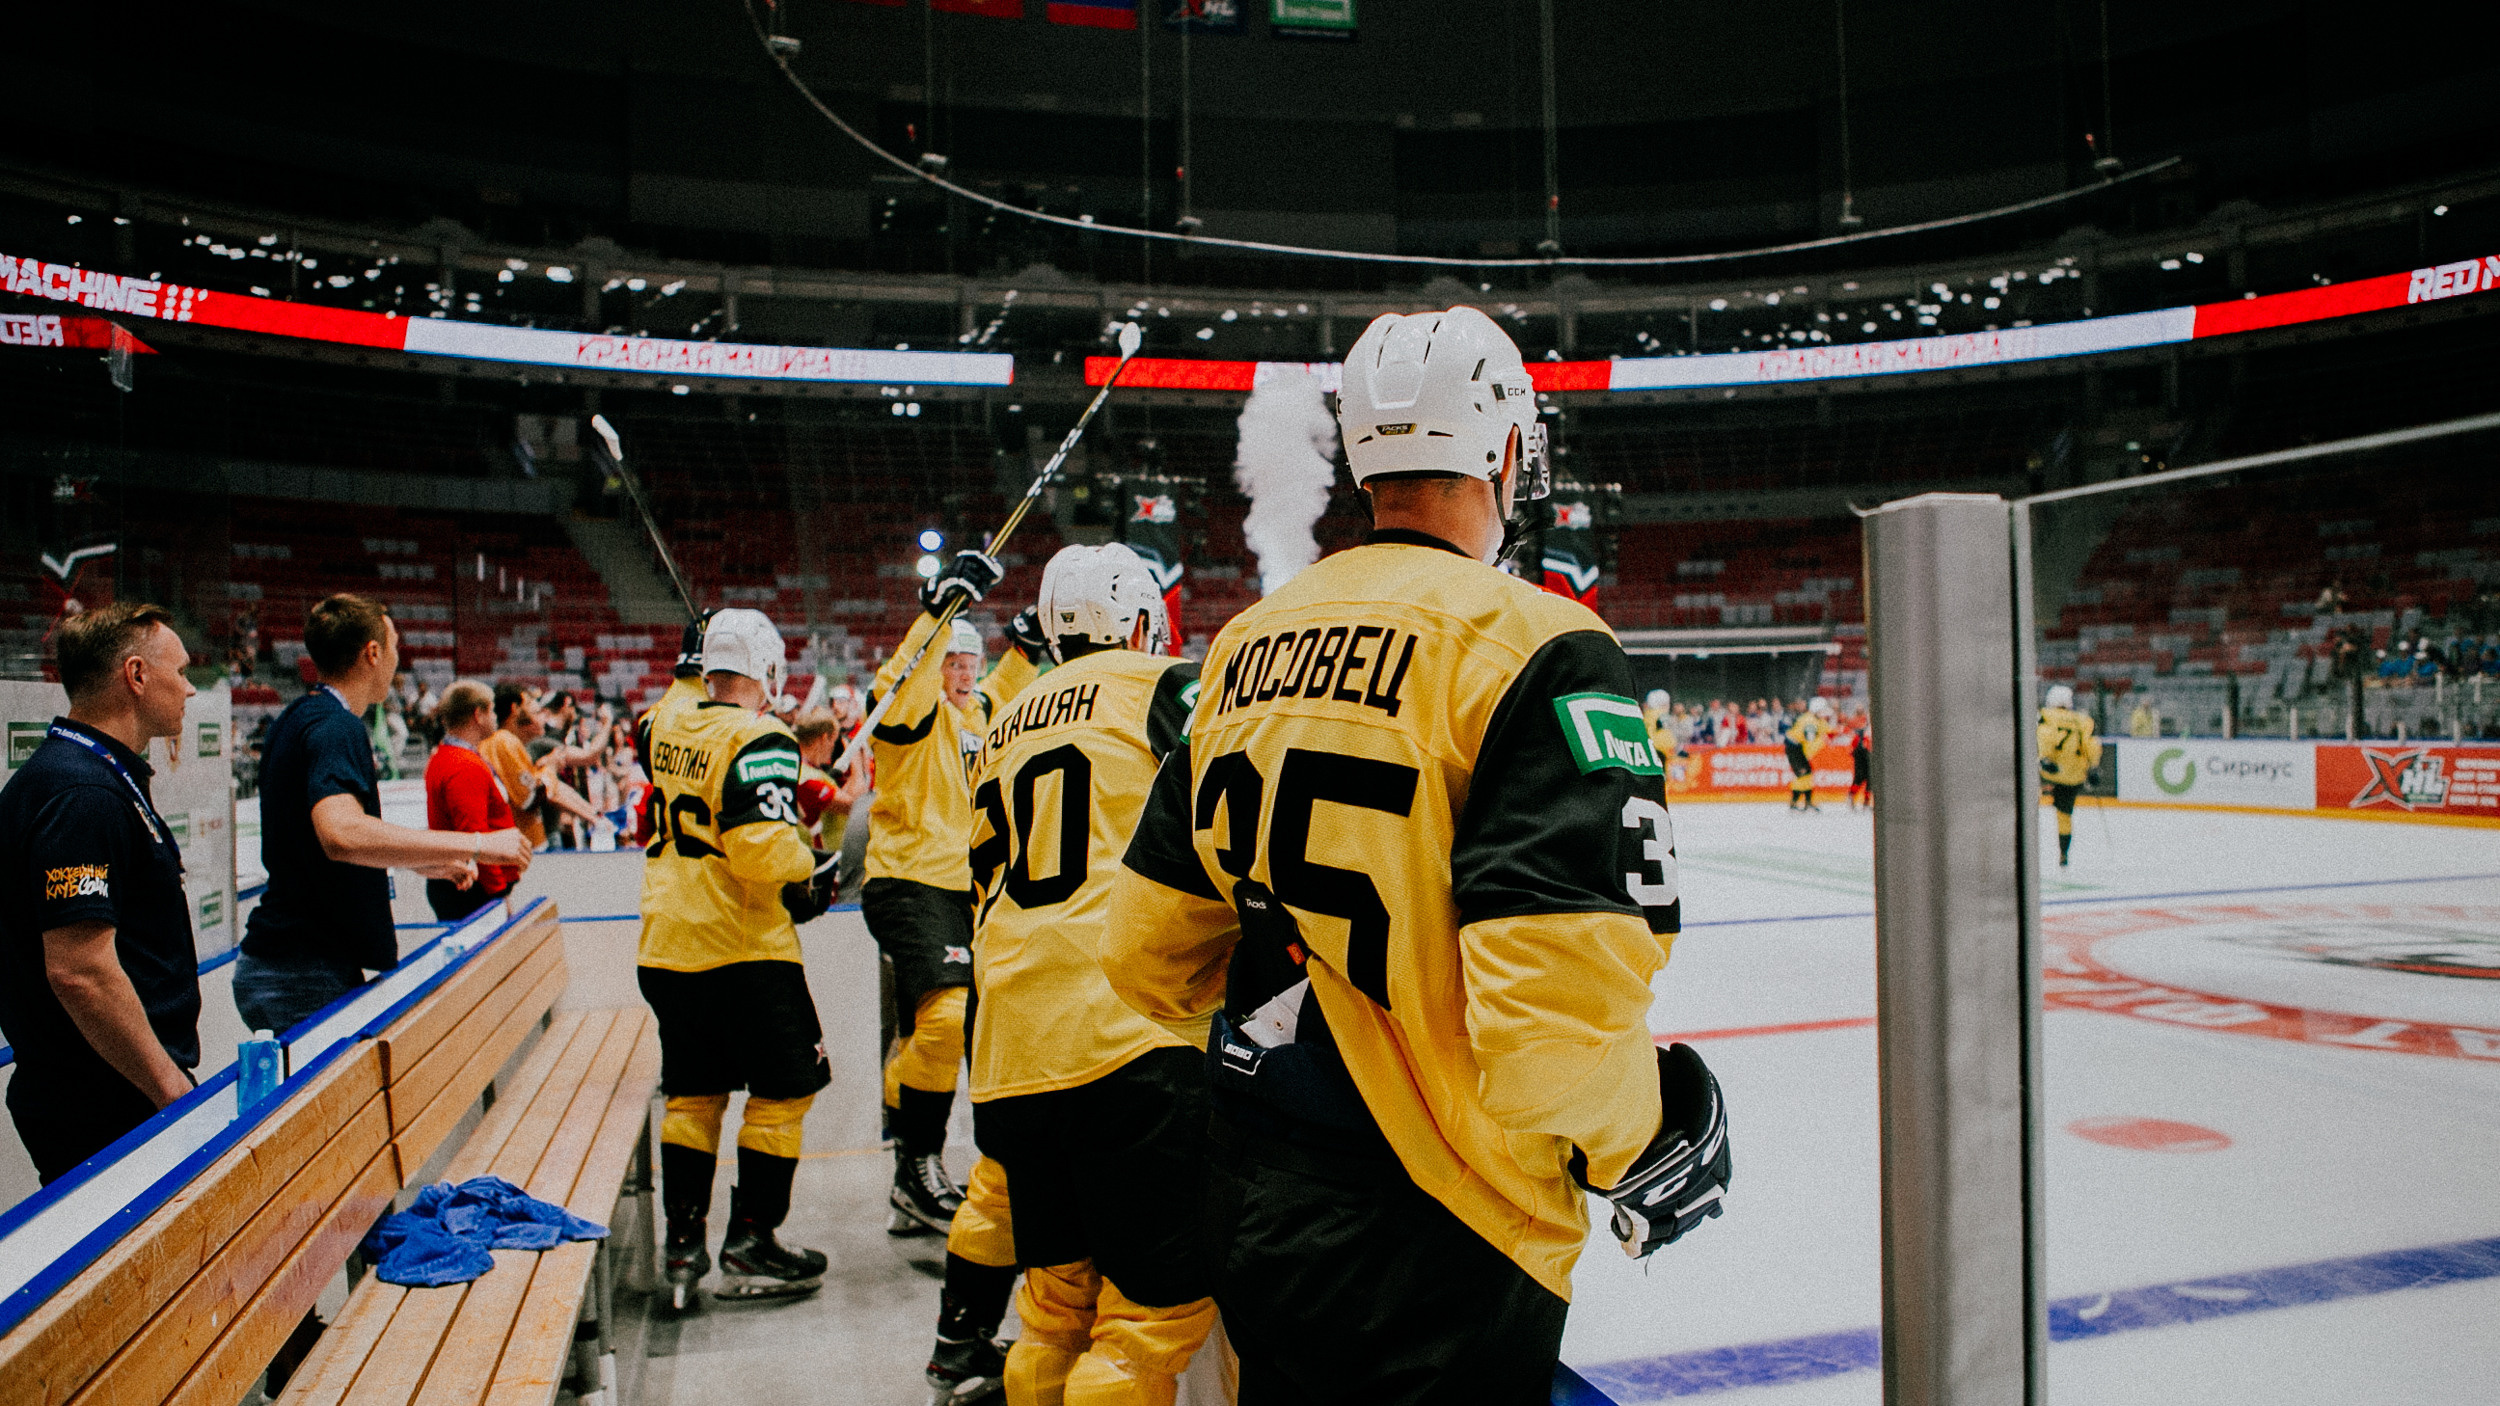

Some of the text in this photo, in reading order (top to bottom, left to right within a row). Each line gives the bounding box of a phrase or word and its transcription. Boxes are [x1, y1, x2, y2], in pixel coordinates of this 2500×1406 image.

[2407, 259, 2480, 304] RED
[1507, 388, 1526, 397] CCM
[1217, 625, 1418, 718] МОСОВЕЦ
[2206, 755, 2293, 780] Сириус
[1621, 795, 1679, 907] 3
